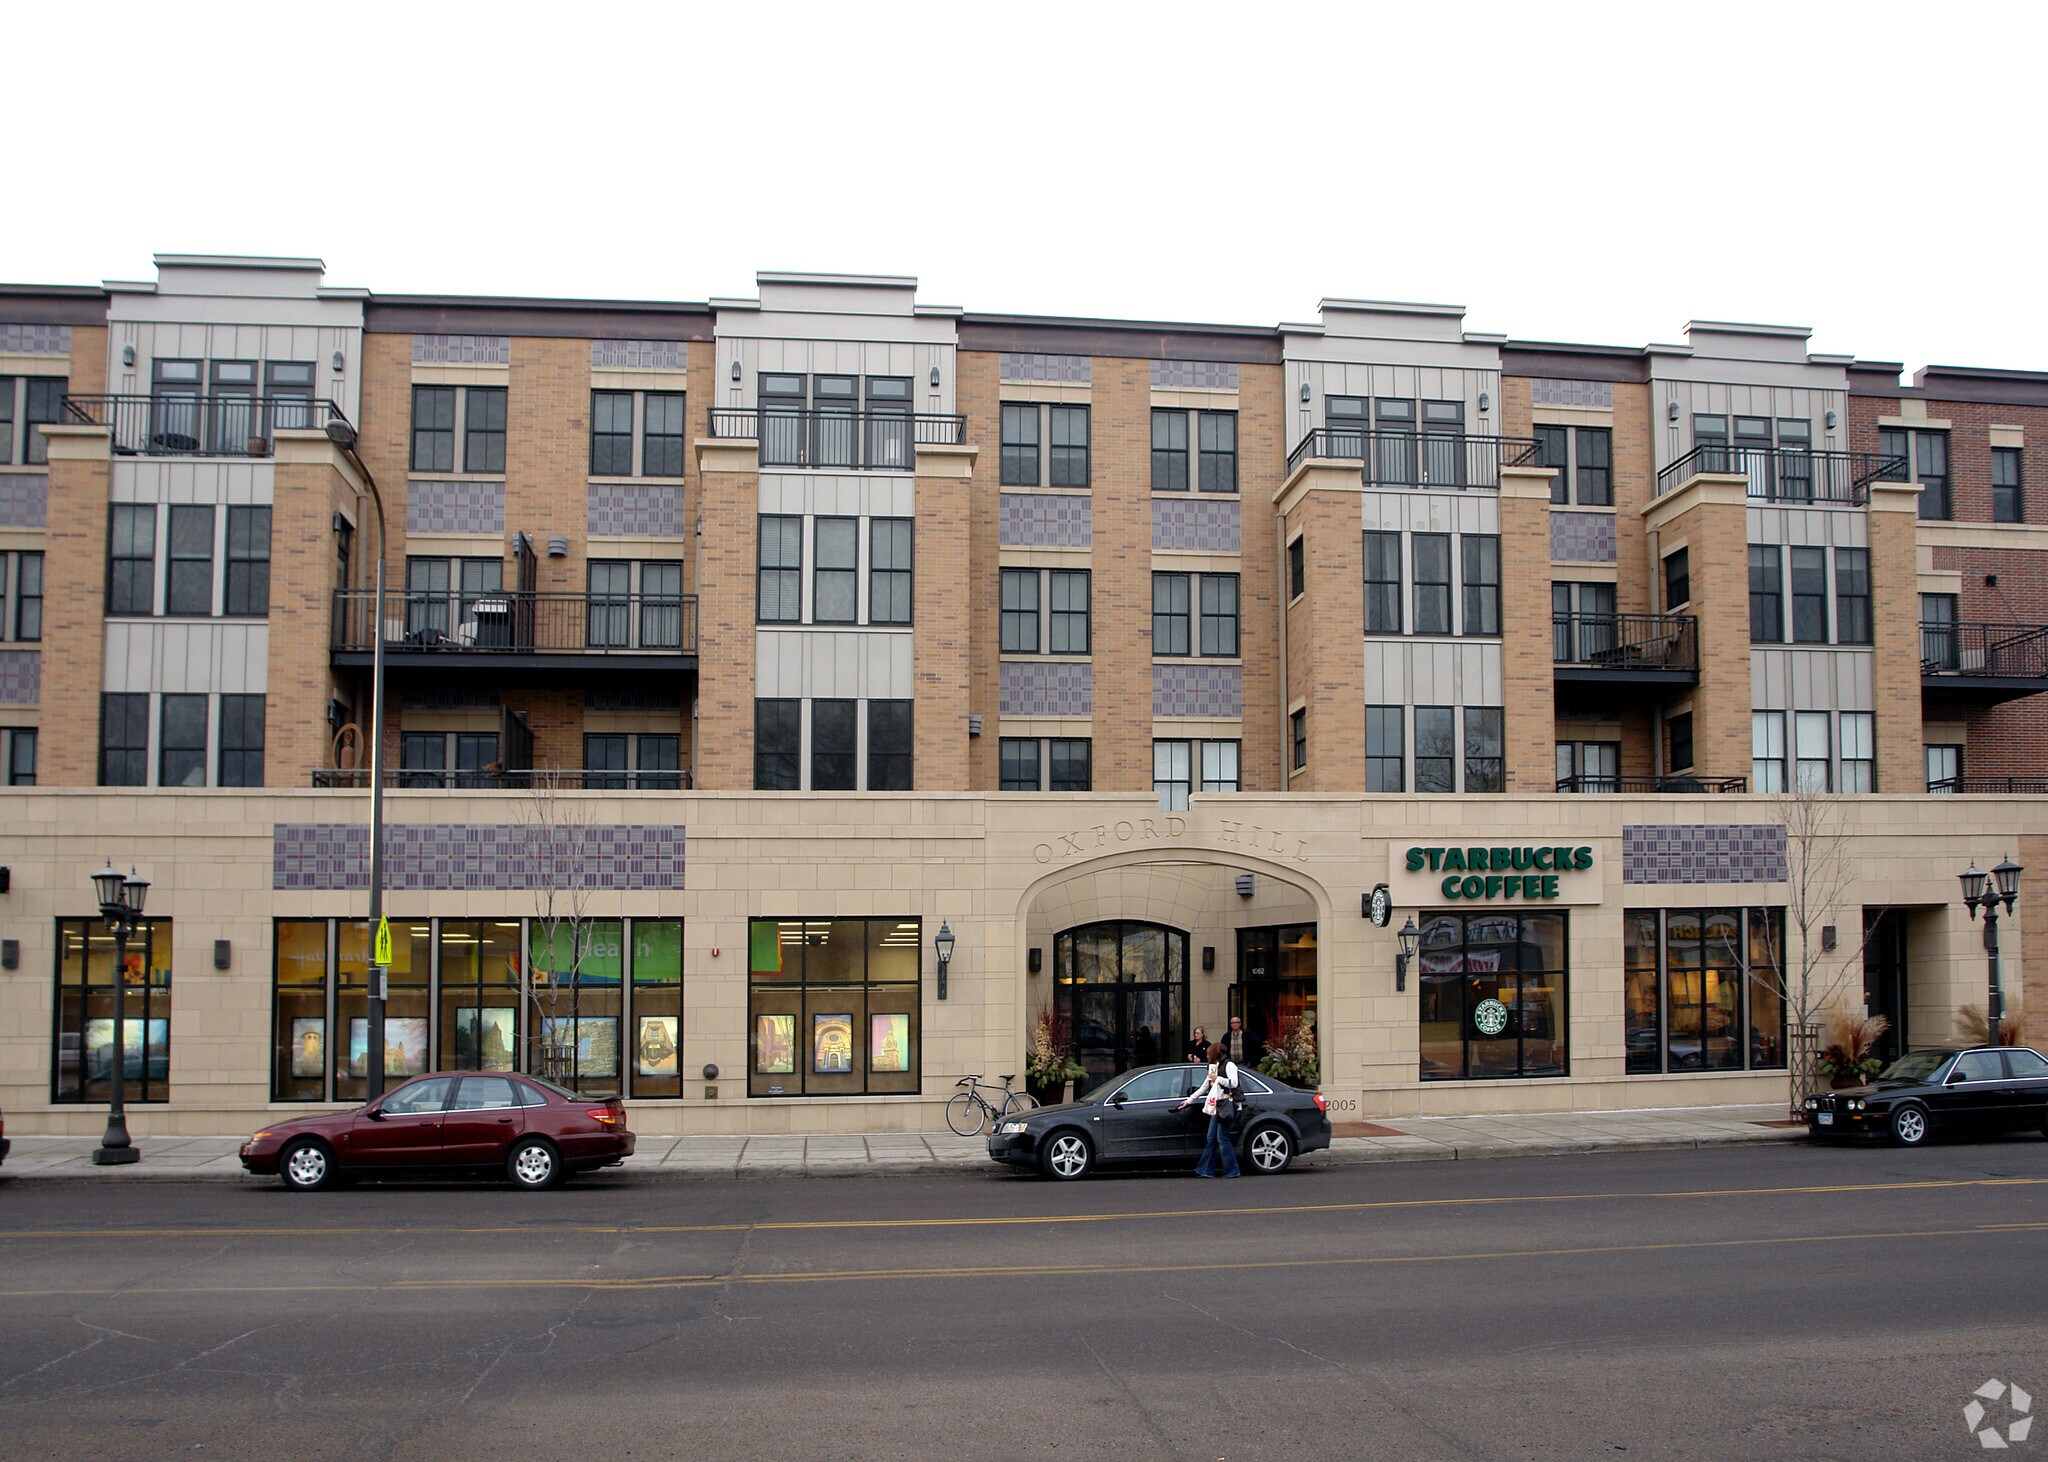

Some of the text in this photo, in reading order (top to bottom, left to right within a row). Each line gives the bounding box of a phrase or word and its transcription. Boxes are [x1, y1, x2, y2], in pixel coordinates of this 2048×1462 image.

[1032, 816, 1309, 864] OXFORD HILL
[1405, 846, 1594, 872] STARBUCKS
[1441, 874, 1560, 900] COFFEE
[1477, 1000, 1505, 1016] STARBUCKS
[1480, 1023, 1502, 1033] COFFEE
[1325, 1099, 1356, 1111] 2005
